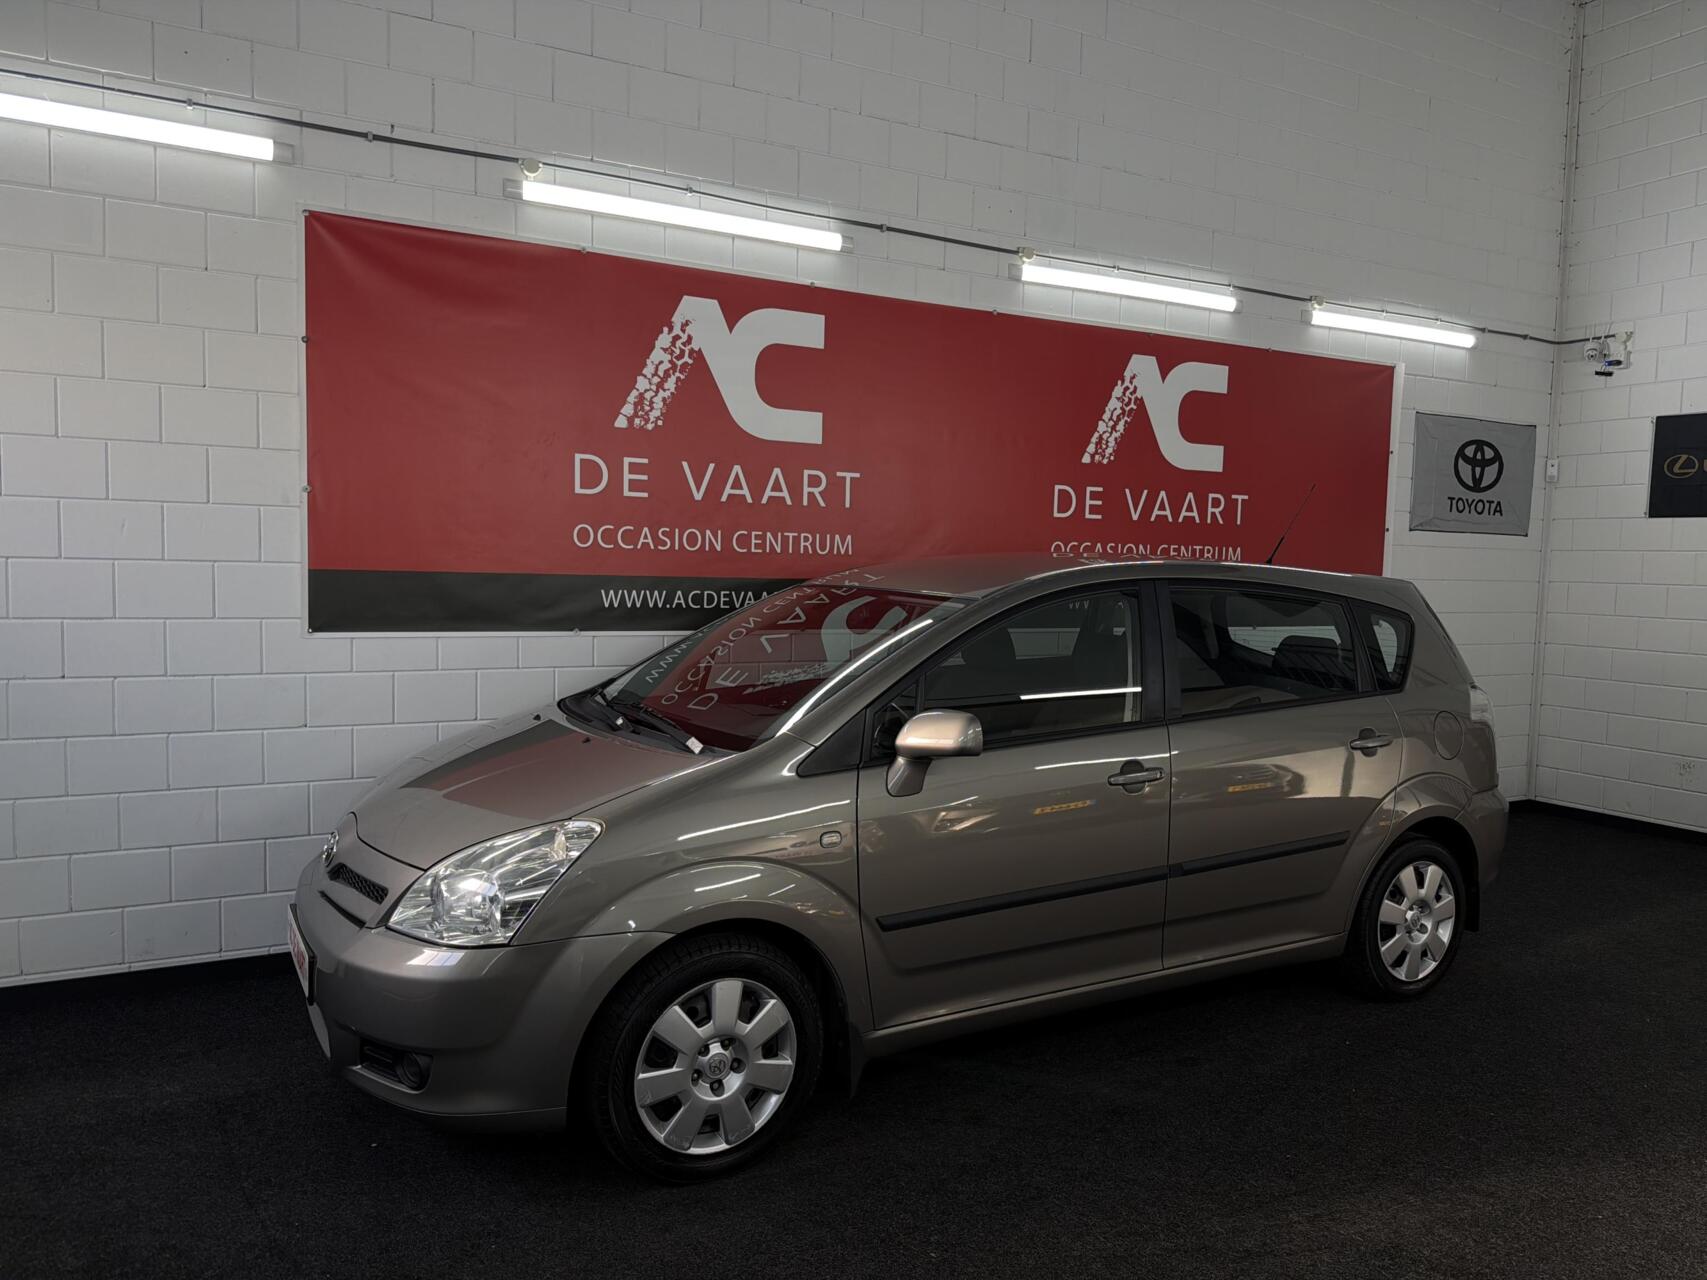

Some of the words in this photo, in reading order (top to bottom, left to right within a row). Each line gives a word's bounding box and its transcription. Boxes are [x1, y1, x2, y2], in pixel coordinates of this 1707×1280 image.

[613, 295, 825, 445] AC
[1081, 354, 1229, 473] AC
[573, 452, 649, 498] DE
[681, 460, 861, 509] VAART
[1052, 484, 1104, 519] DE
[1125, 488, 1249, 526] VAART
[1448, 496, 1503, 517] TOYOTA
[572, 523, 722, 552] OCCASION
[732, 529, 853, 556] CENTRUM
[1157, 544, 1242, 562] CENTRUM
